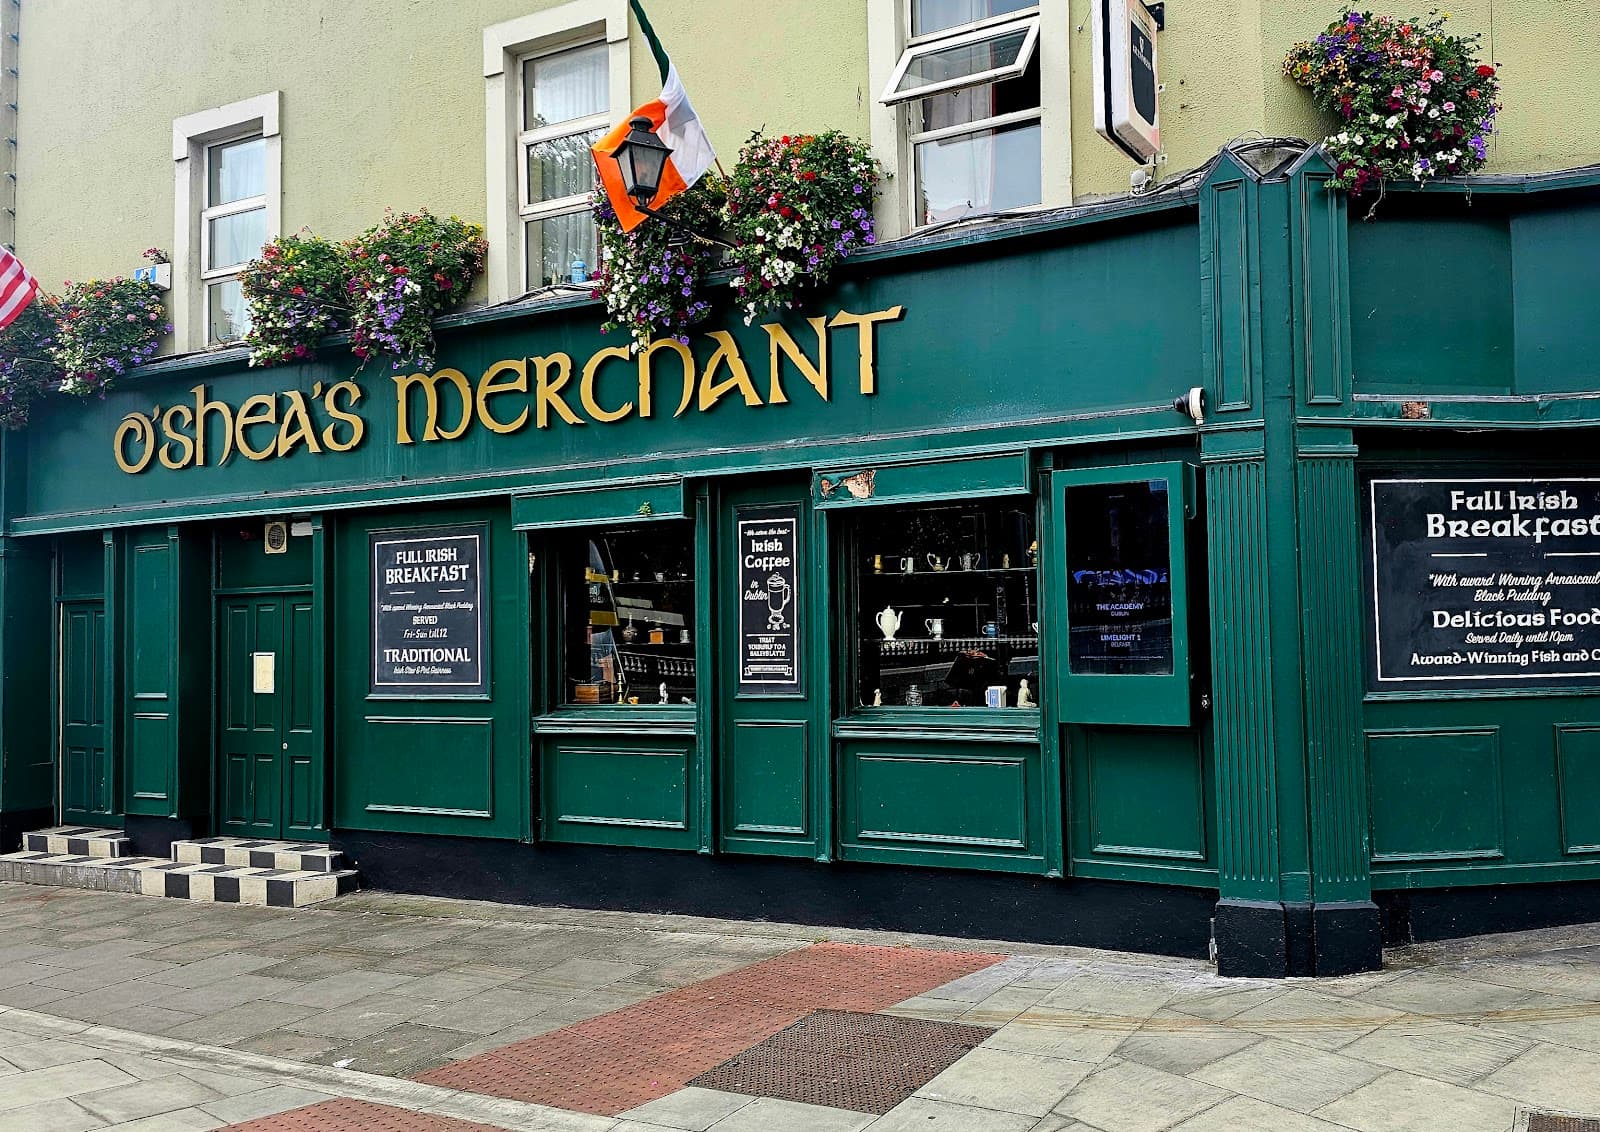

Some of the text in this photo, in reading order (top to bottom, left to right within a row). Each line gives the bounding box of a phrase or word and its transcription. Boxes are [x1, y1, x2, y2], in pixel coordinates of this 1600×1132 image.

[1451, 490, 1578, 511] Full Irish
[1427, 513, 1600, 543] Breakfast
[751, 538, 783, 552] Irish
[396, 547, 457, 565] FULL IRISH
[744, 555, 790, 571] Coffee
[385, 564, 469, 584] BREAKFAST
[1460, 573, 1495, 587] award
[1498, 573, 1543, 591] Winning
[744, 589, 768, 600] Dublin
[1474, 588, 1551, 606] Black Pudding
[412, 615, 438, 625] SERVED
[1432, 610, 1545, 628] Delicious
[439, 628, 448, 638] 12
[1465, 631, 1574, 648] Served Daily until 10pm
[383, 647, 471, 663] TRADITIONAL
[1531, 650, 1560, 662] Fish
[1562, 649, 1589, 662] and
